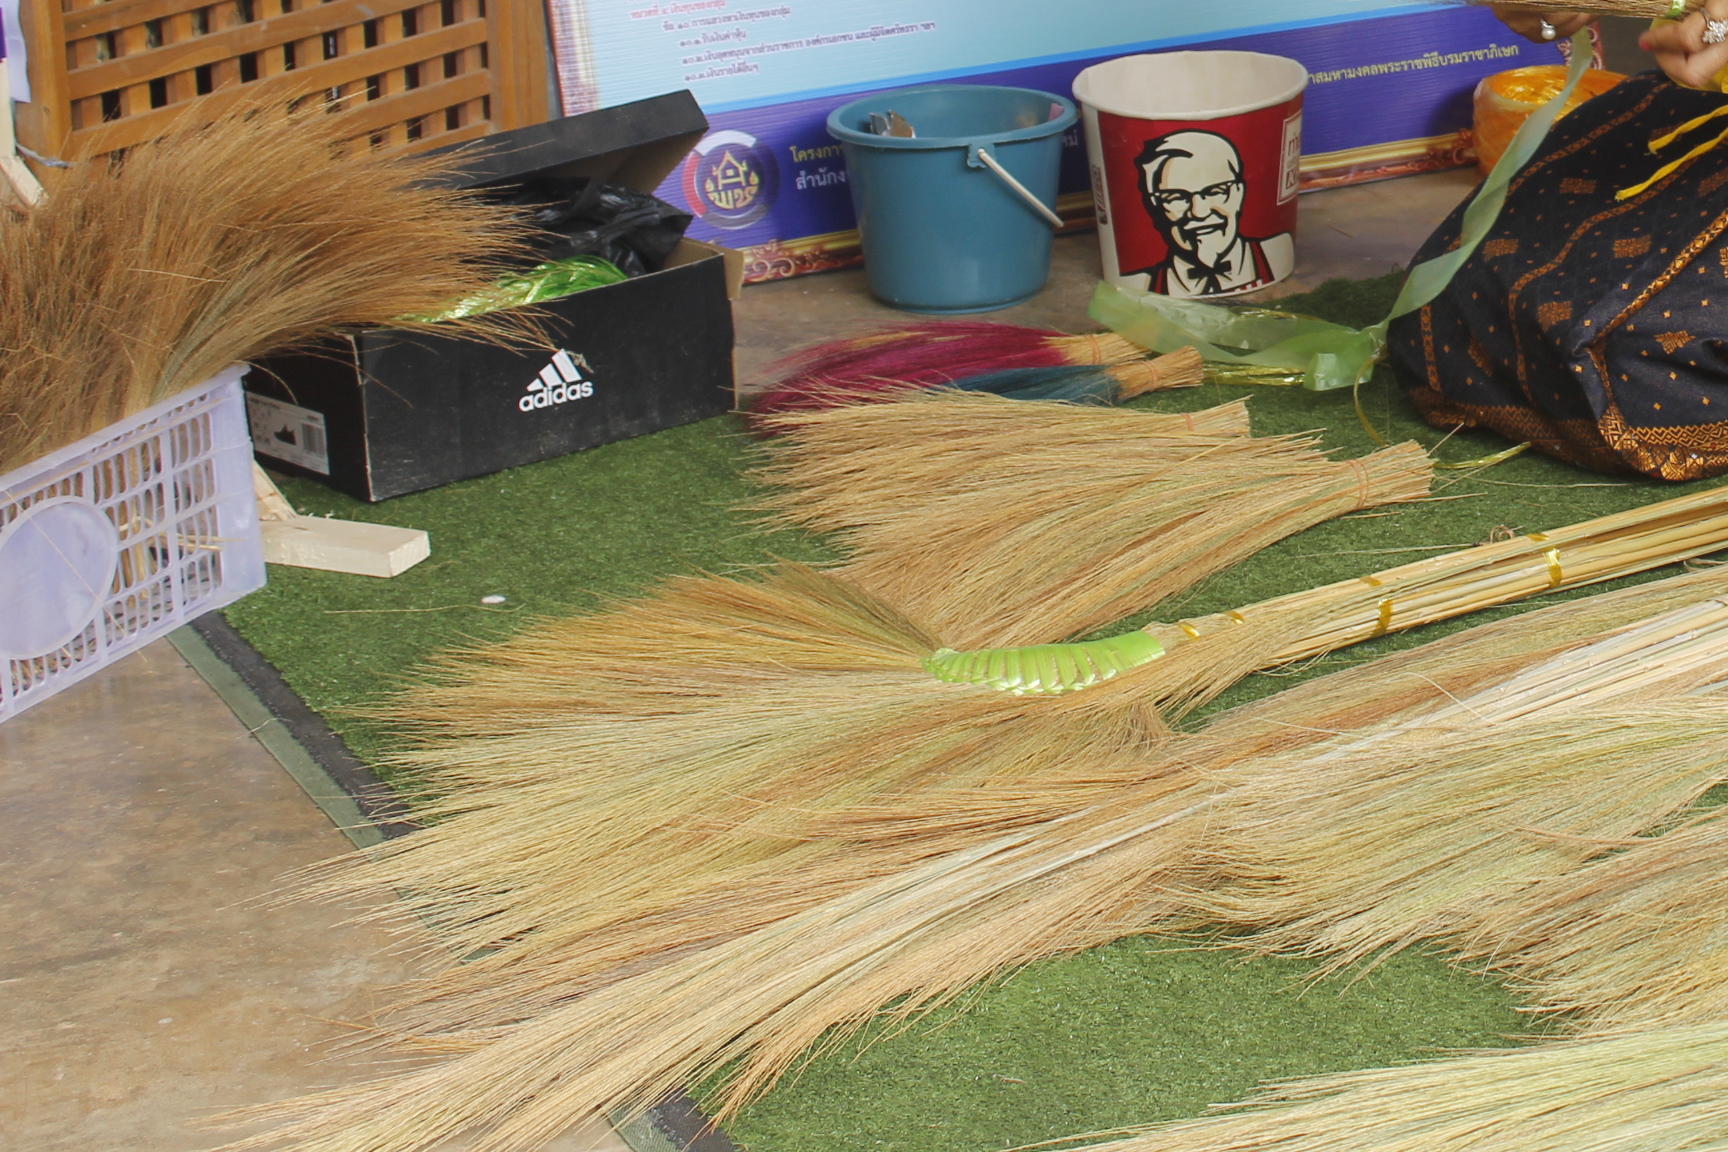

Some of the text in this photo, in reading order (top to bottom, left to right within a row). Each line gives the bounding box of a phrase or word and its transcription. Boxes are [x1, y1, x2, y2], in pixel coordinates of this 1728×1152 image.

[1307, 44, 1519, 85] าสมหามงคลพระราชพิธีบรมราชาภิเษก
[789, 144, 842, 163] โครงกา
[796, 167, 848, 190] สำนักง
[519, 378, 593, 412] adidas
